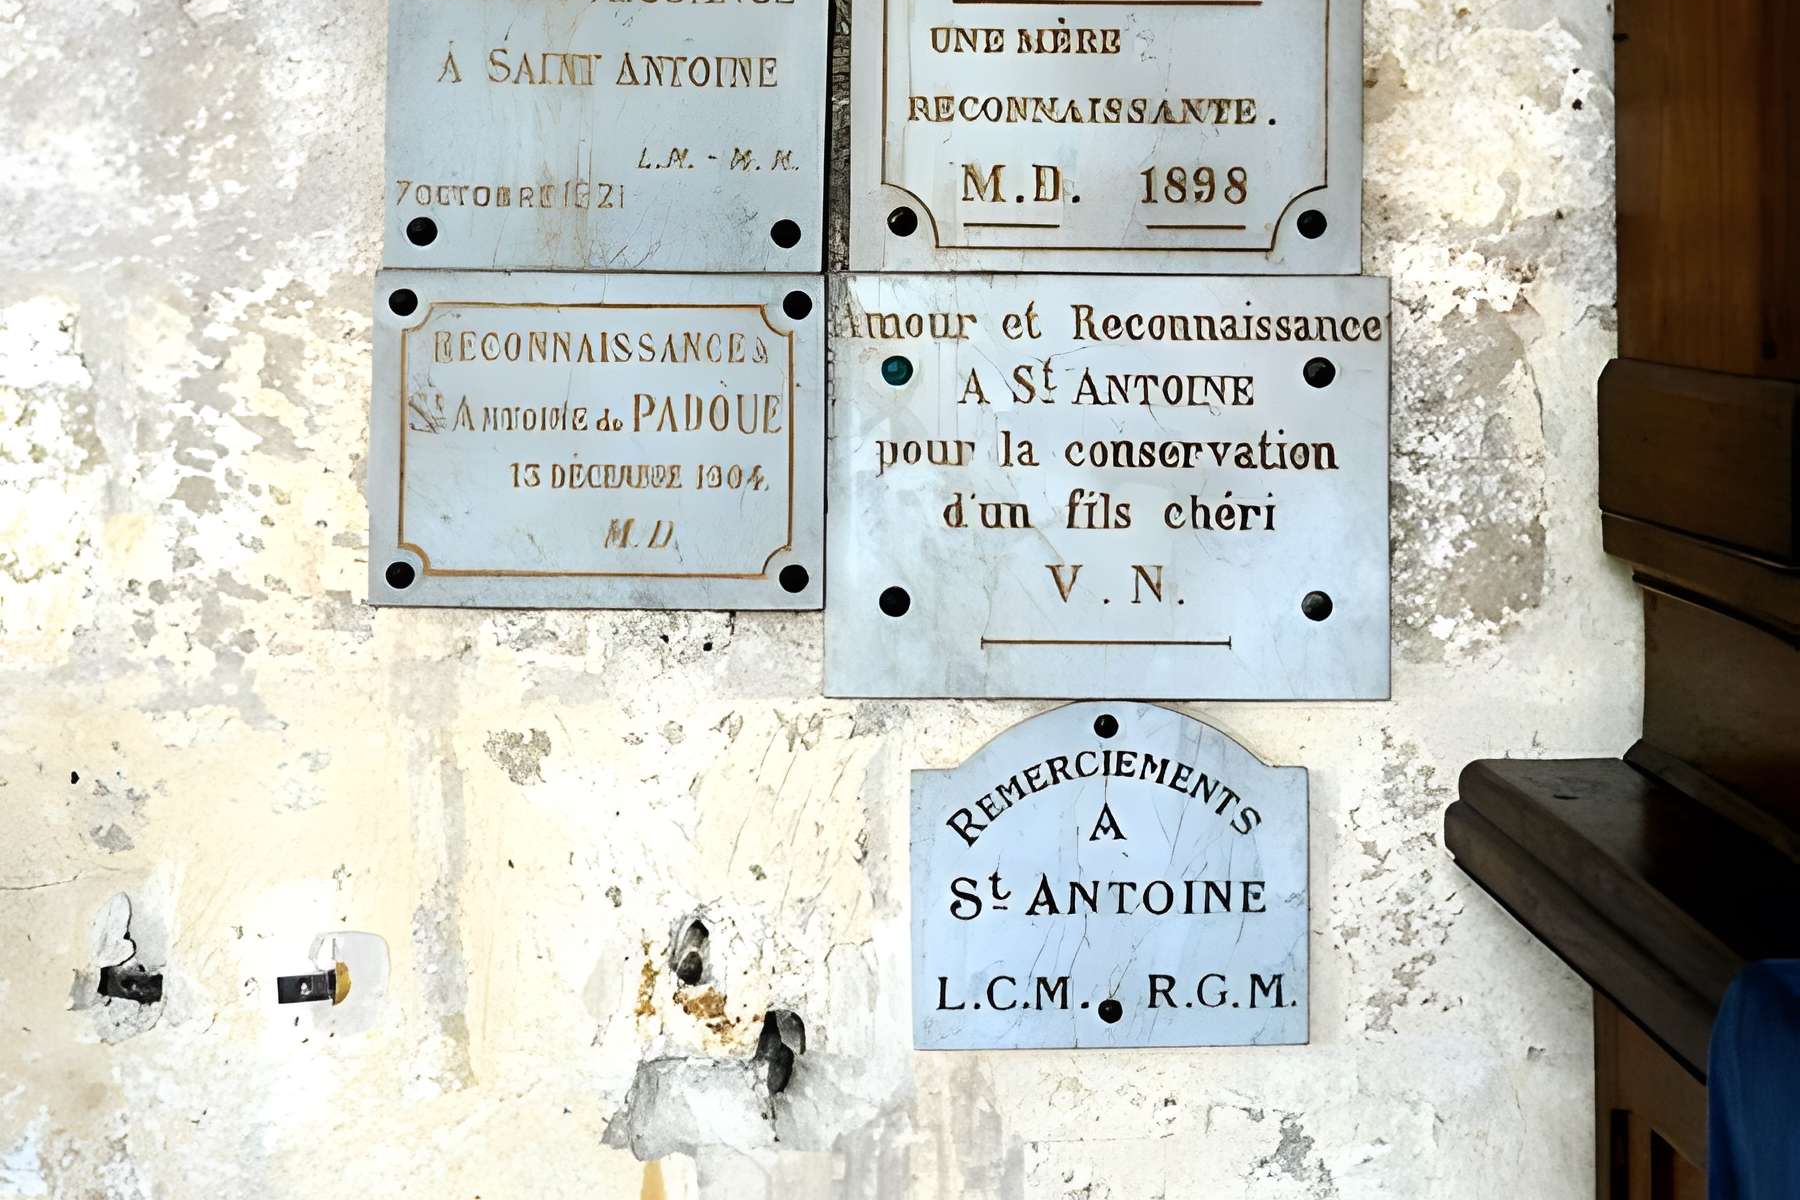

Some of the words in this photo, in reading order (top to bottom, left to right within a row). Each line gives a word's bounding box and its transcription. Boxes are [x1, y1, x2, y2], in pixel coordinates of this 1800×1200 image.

[930, 27, 1005, 54] UNE
[488, 48, 602, 86] SAINT
[615, 52, 778, 88] ANTOINE
[1140, 166, 1248, 204] 1898
[1003, 301, 1042, 339] et
[1070, 300, 1383, 342] Reconnaissance
[434, 331, 745, 363] RECONNAISSANCE
[958, 368, 990, 404] A
[632, 393, 783, 434] PADOUE
[876, 438, 975, 477] pour
[1000, 430, 1039, 467] la
[1064, 429, 1340, 470] conservation
[942, 492, 1033, 529] d'un
[1065, 488, 1132, 530] fils
[1163, 490, 1277, 531] chéri
[946, 750, 1262, 847] REMERCIEMENTS
[1089, 803, 1127, 841] A
[1024, 873, 1267, 916] ANTOINE
[936, 976, 1090, 1011] L.C.M.
[1148, 974, 1298, 1010] R.G.M.
